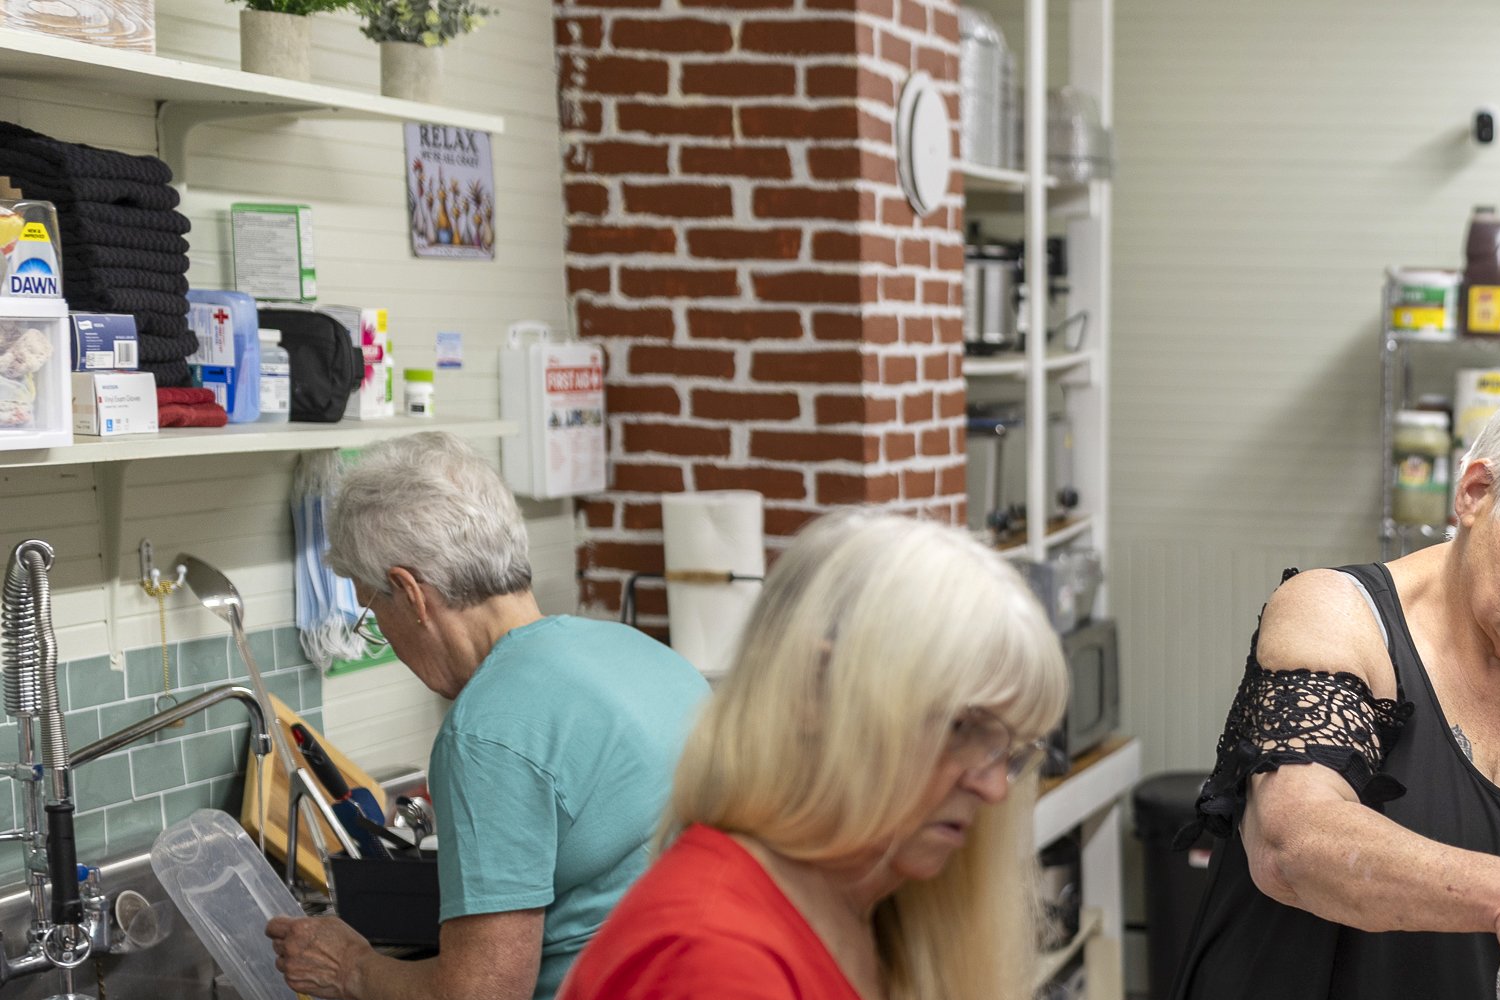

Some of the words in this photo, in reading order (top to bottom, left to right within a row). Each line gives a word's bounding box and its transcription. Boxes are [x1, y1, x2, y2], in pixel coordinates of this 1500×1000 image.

[419, 124, 479, 154] RELAX
[11, 276, 57, 294] DAWN
[549, 371, 571, 390] FIRST
[575, 371, 590, 389] AID
